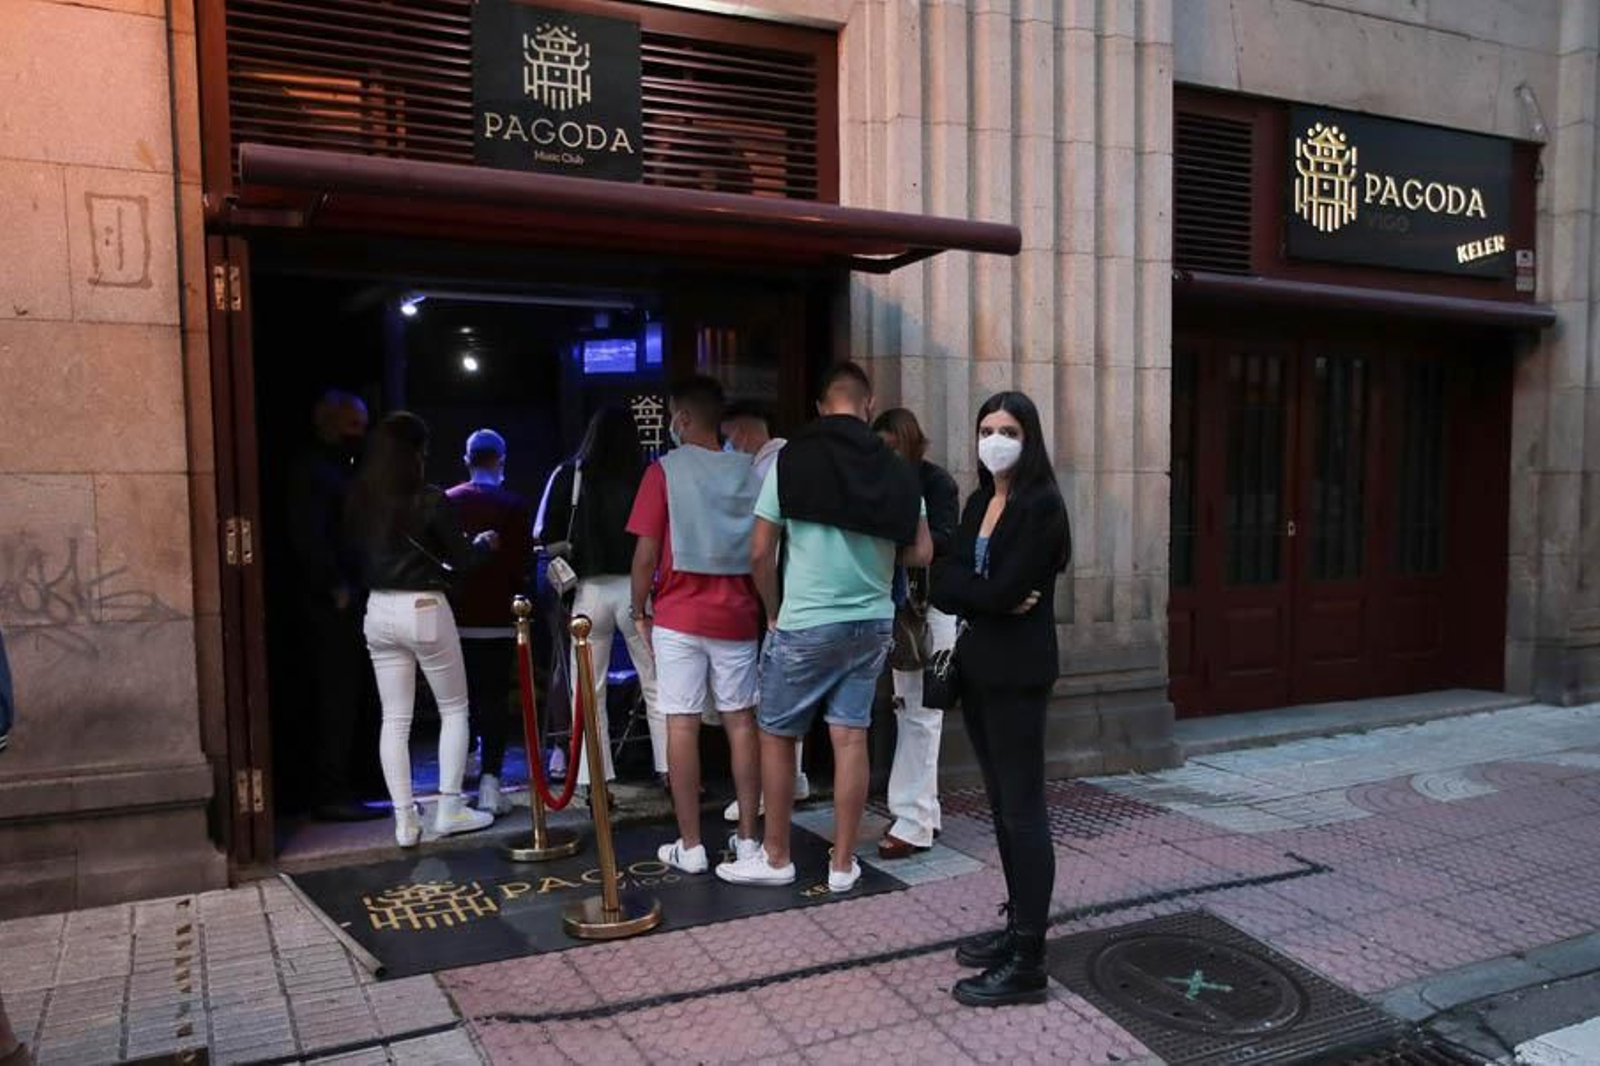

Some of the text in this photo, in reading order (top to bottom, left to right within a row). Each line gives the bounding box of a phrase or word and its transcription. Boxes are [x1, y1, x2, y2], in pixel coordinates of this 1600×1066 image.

[484, 112, 634, 154] PAGODA
[561, 152, 584, 165] Club
[1364, 172, 1486, 218] PAGODA
[1456, 235, 1505, 263] KELER
